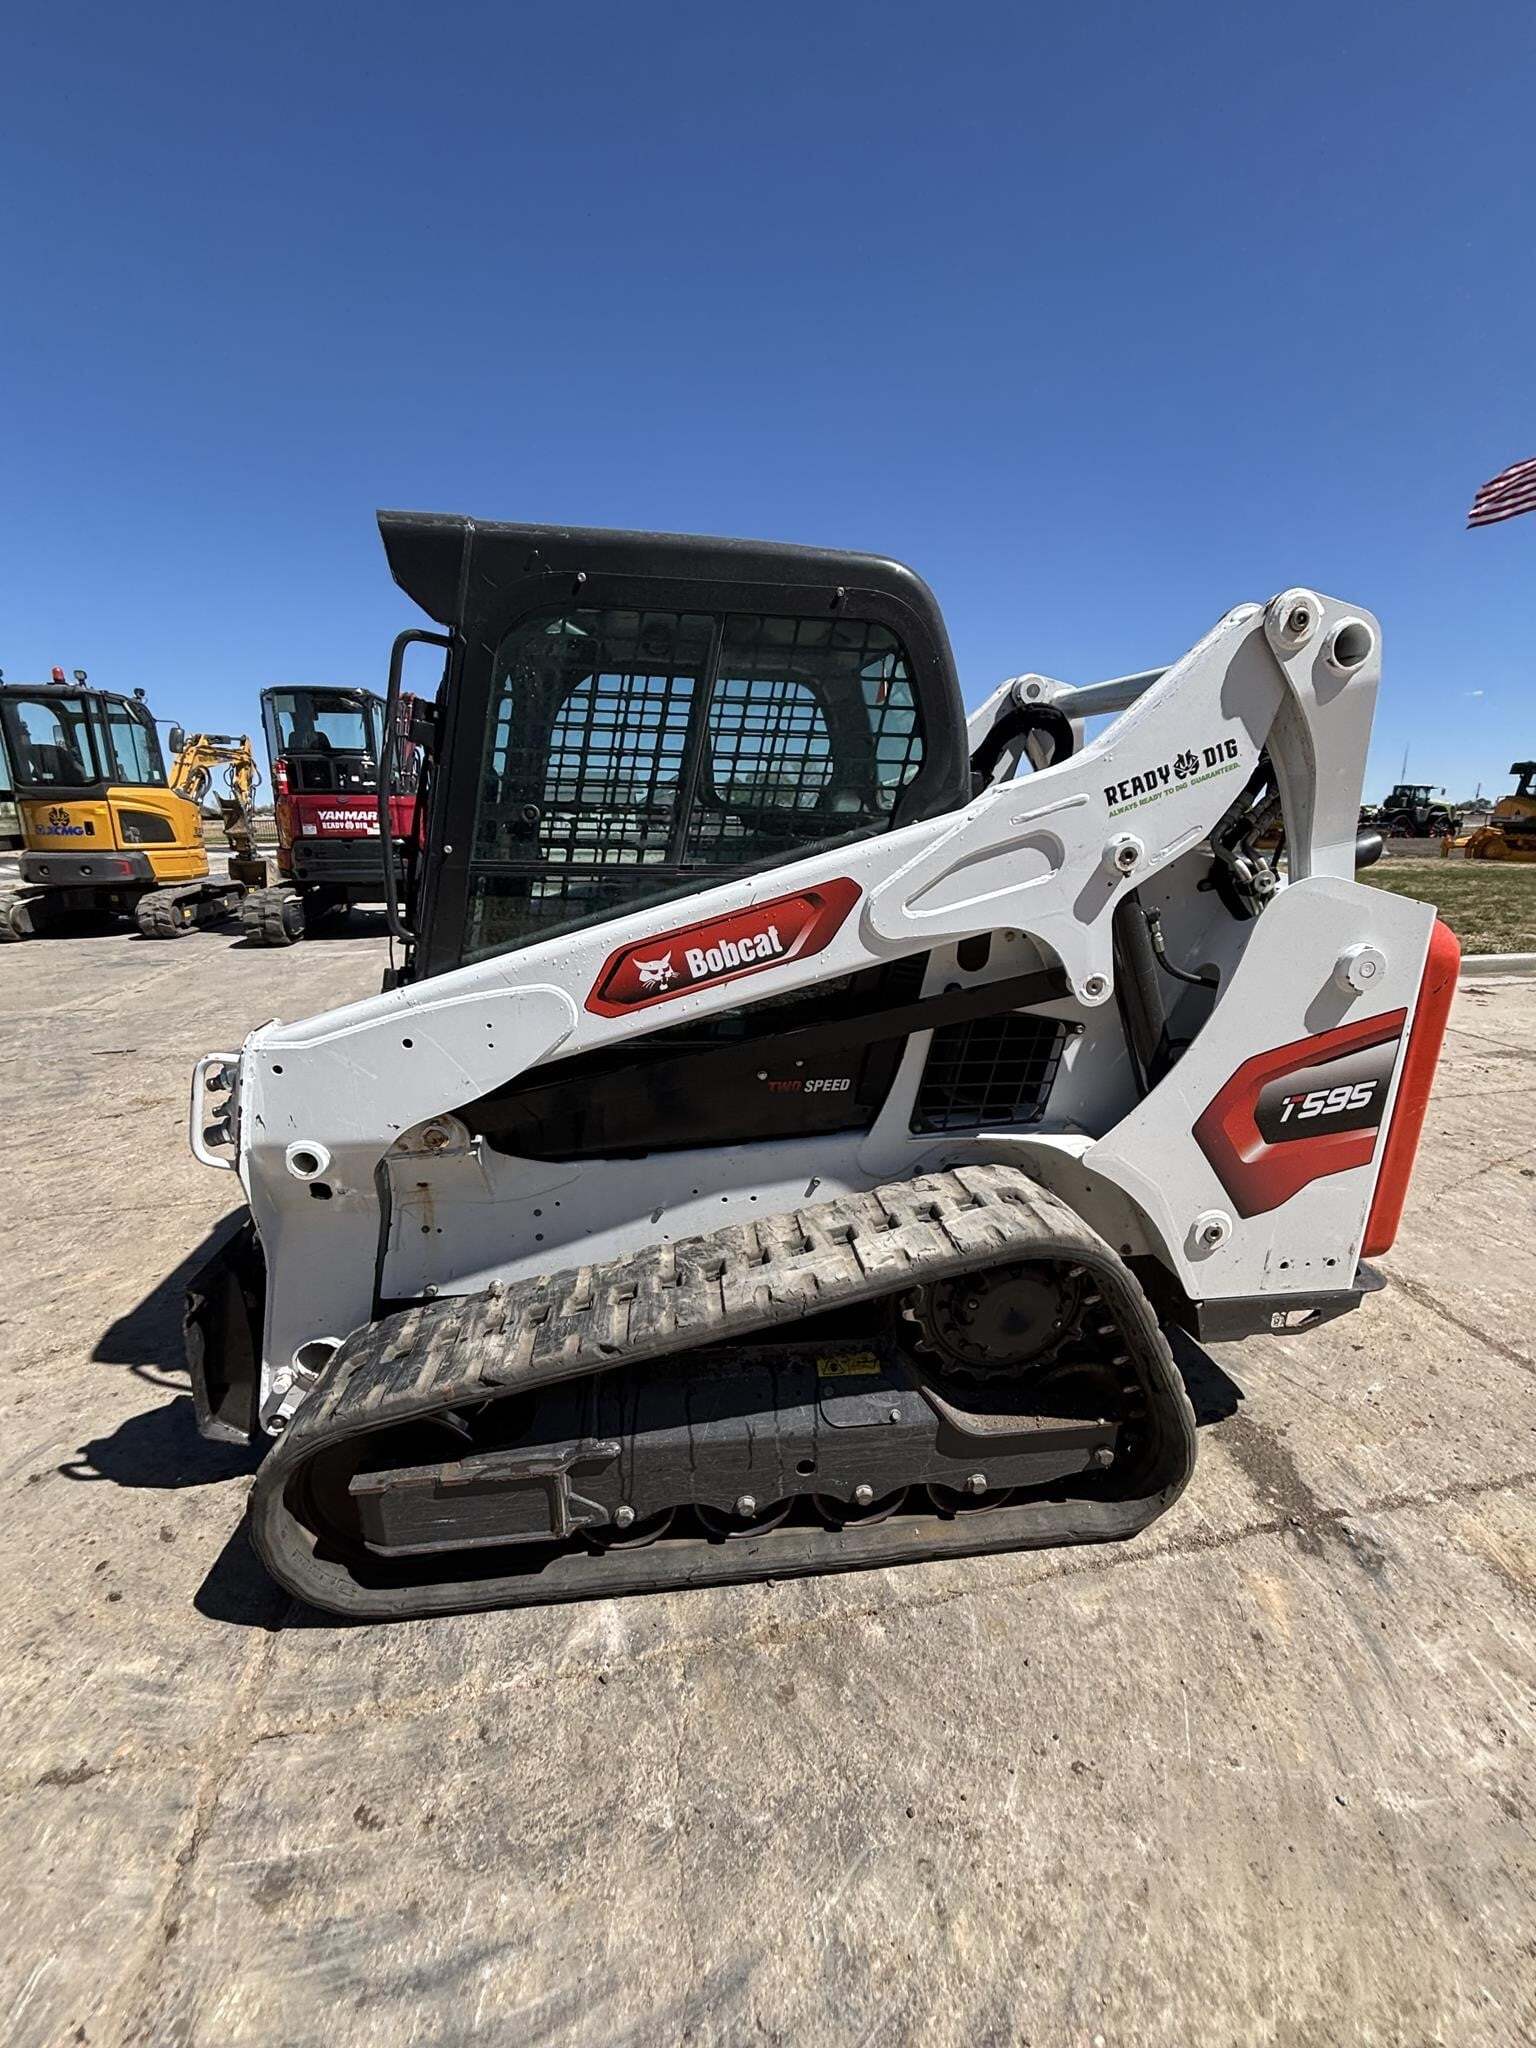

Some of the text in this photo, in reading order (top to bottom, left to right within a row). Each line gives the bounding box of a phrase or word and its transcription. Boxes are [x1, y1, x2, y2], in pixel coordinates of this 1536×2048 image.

[1104, 738, 1238, 806] READY DIG
[317, 810, 378, 821] YANMAR
[1109, 800, 1138, 818] ALWAYS
[1139, 791, 1162, 806] READY
[1164, 787, 1175, 796] TO
[685, 925, 783, 978] Bobcat
[767, 1079, 851, 1093] TWO SPEED
[1280, 1080, 1378, 1123] T595
